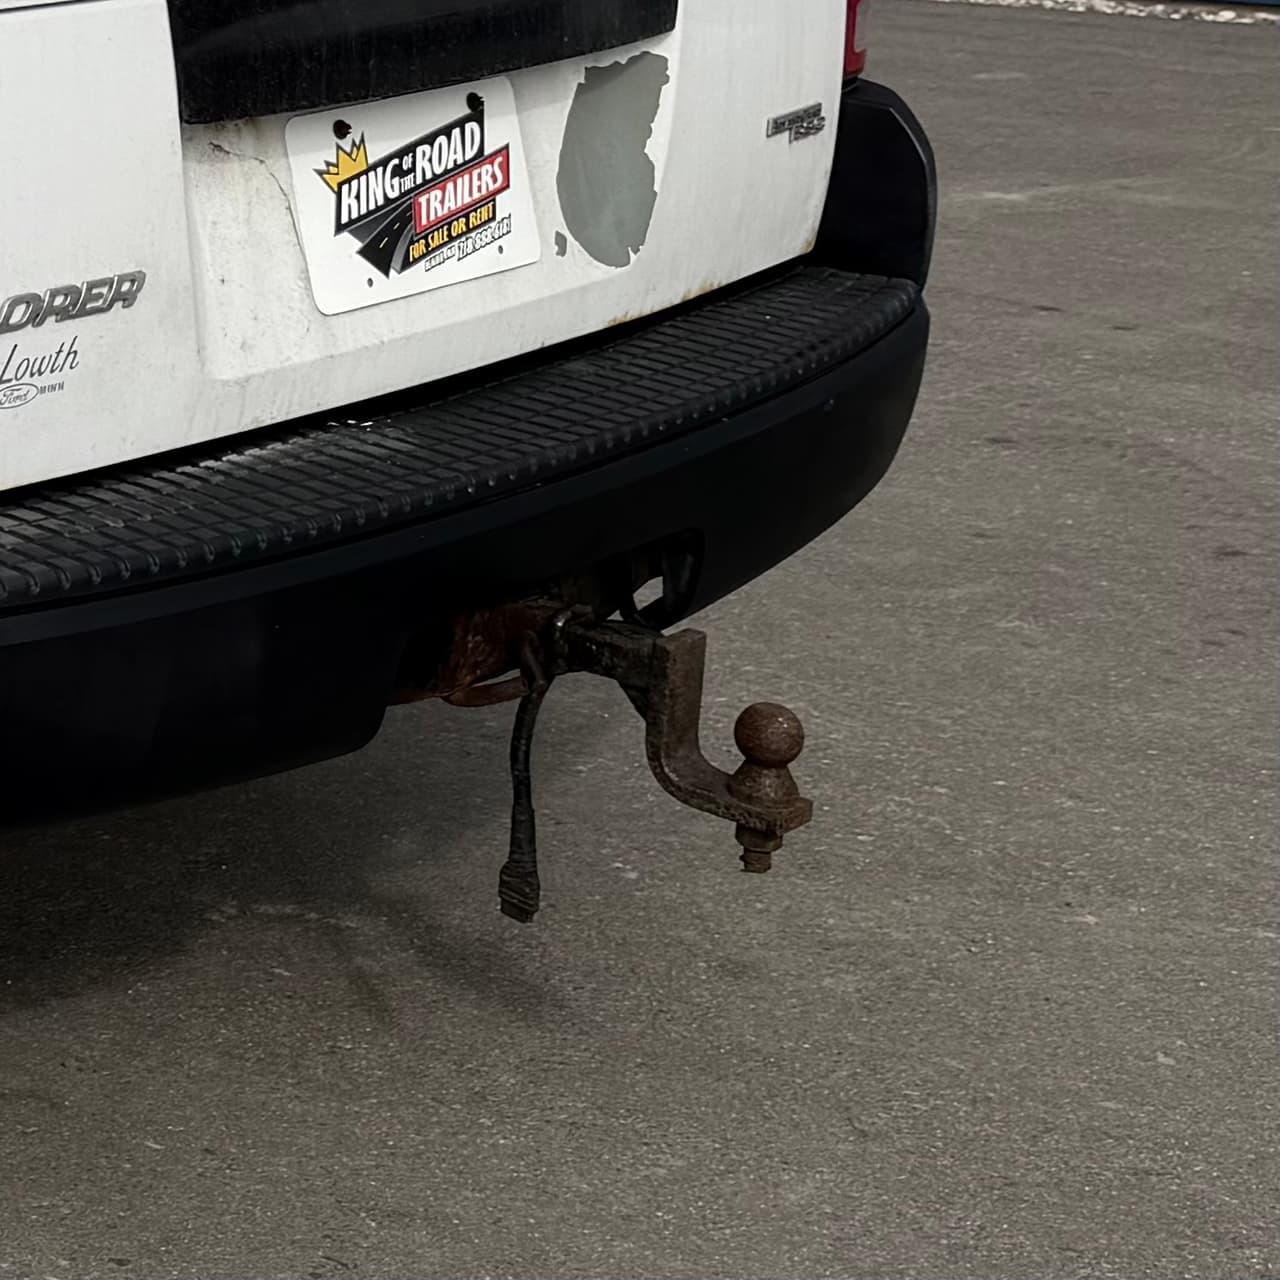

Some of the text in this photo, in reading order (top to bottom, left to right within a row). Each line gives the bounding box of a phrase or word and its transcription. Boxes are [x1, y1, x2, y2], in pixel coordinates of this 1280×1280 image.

[341, 121, 481, 225] KING OF THE ROAD
[418, 156, 504, 226] TRAILERS
[409, 239, 427, 263] FOR
[428, 225, 450, 251] SALE
[451, 217, 467, 237] OR
[469, 201, 495, 229] RENT
